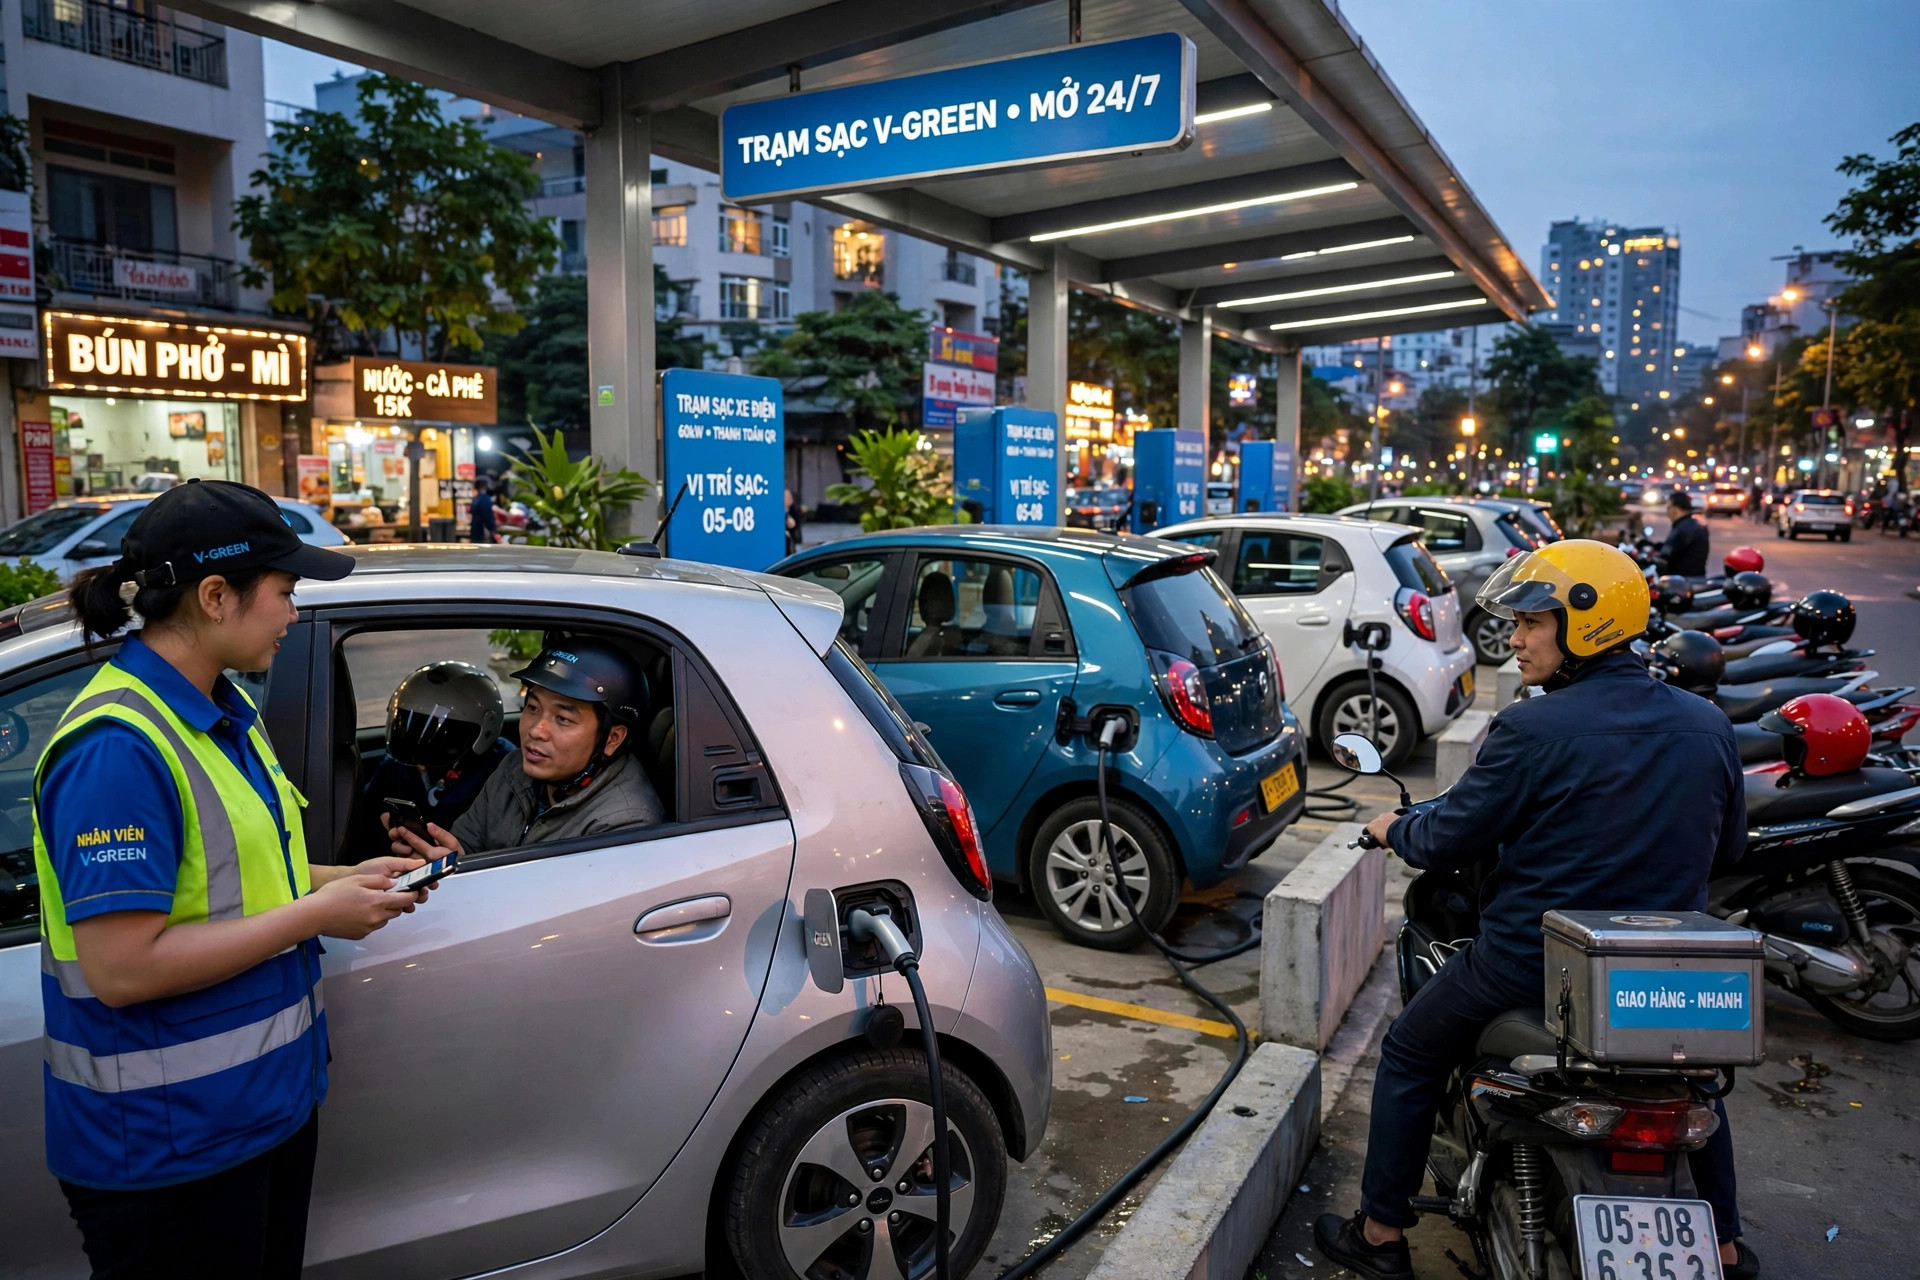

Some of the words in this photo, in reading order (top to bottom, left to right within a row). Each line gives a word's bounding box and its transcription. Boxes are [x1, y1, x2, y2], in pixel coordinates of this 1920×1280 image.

[738, 128, 809, 167] TRẠM
[815, 119, 868, 158] SẠC
[872, 99, 997, 144] V-GREEN
[1030, 76, 1080, 122] MỞ
[1087, 74, 1160, 114] 24/7
[68, 327, 147, 377] BÚN
[156, 334, 226, 382] PHỞ
[252, 343, 290, 386] MÌ
[363, 364, 413, 394] NƯỚC
[373, 394, 412, 417] 15K
[676, 393, 710, 419] TRẠM
[712, 397, 734, 420] SẠC
[735, 398, 750, 417] XE
[686, 474, 703, 501] VỊ
[706, 467, 732, 495] TRÍ
[734, 473, 769, 500] SẠC:
[703, 506, 755, 534] 05-08
[193, 541, 250, 563] V-GREEN
[77, 827, 110, 847] NHÂN
[113, 824, 144, 842] VIÊN
[80, 847, 146, 867] V-GREEN
[1616, 990, 1646, 1008] GIAO
[1650, 986, 1686, 1008] HÀNG
[1697, 992, 1743, 1008] NHANH
[1594, 1203, 1696, 1248] 05-08
